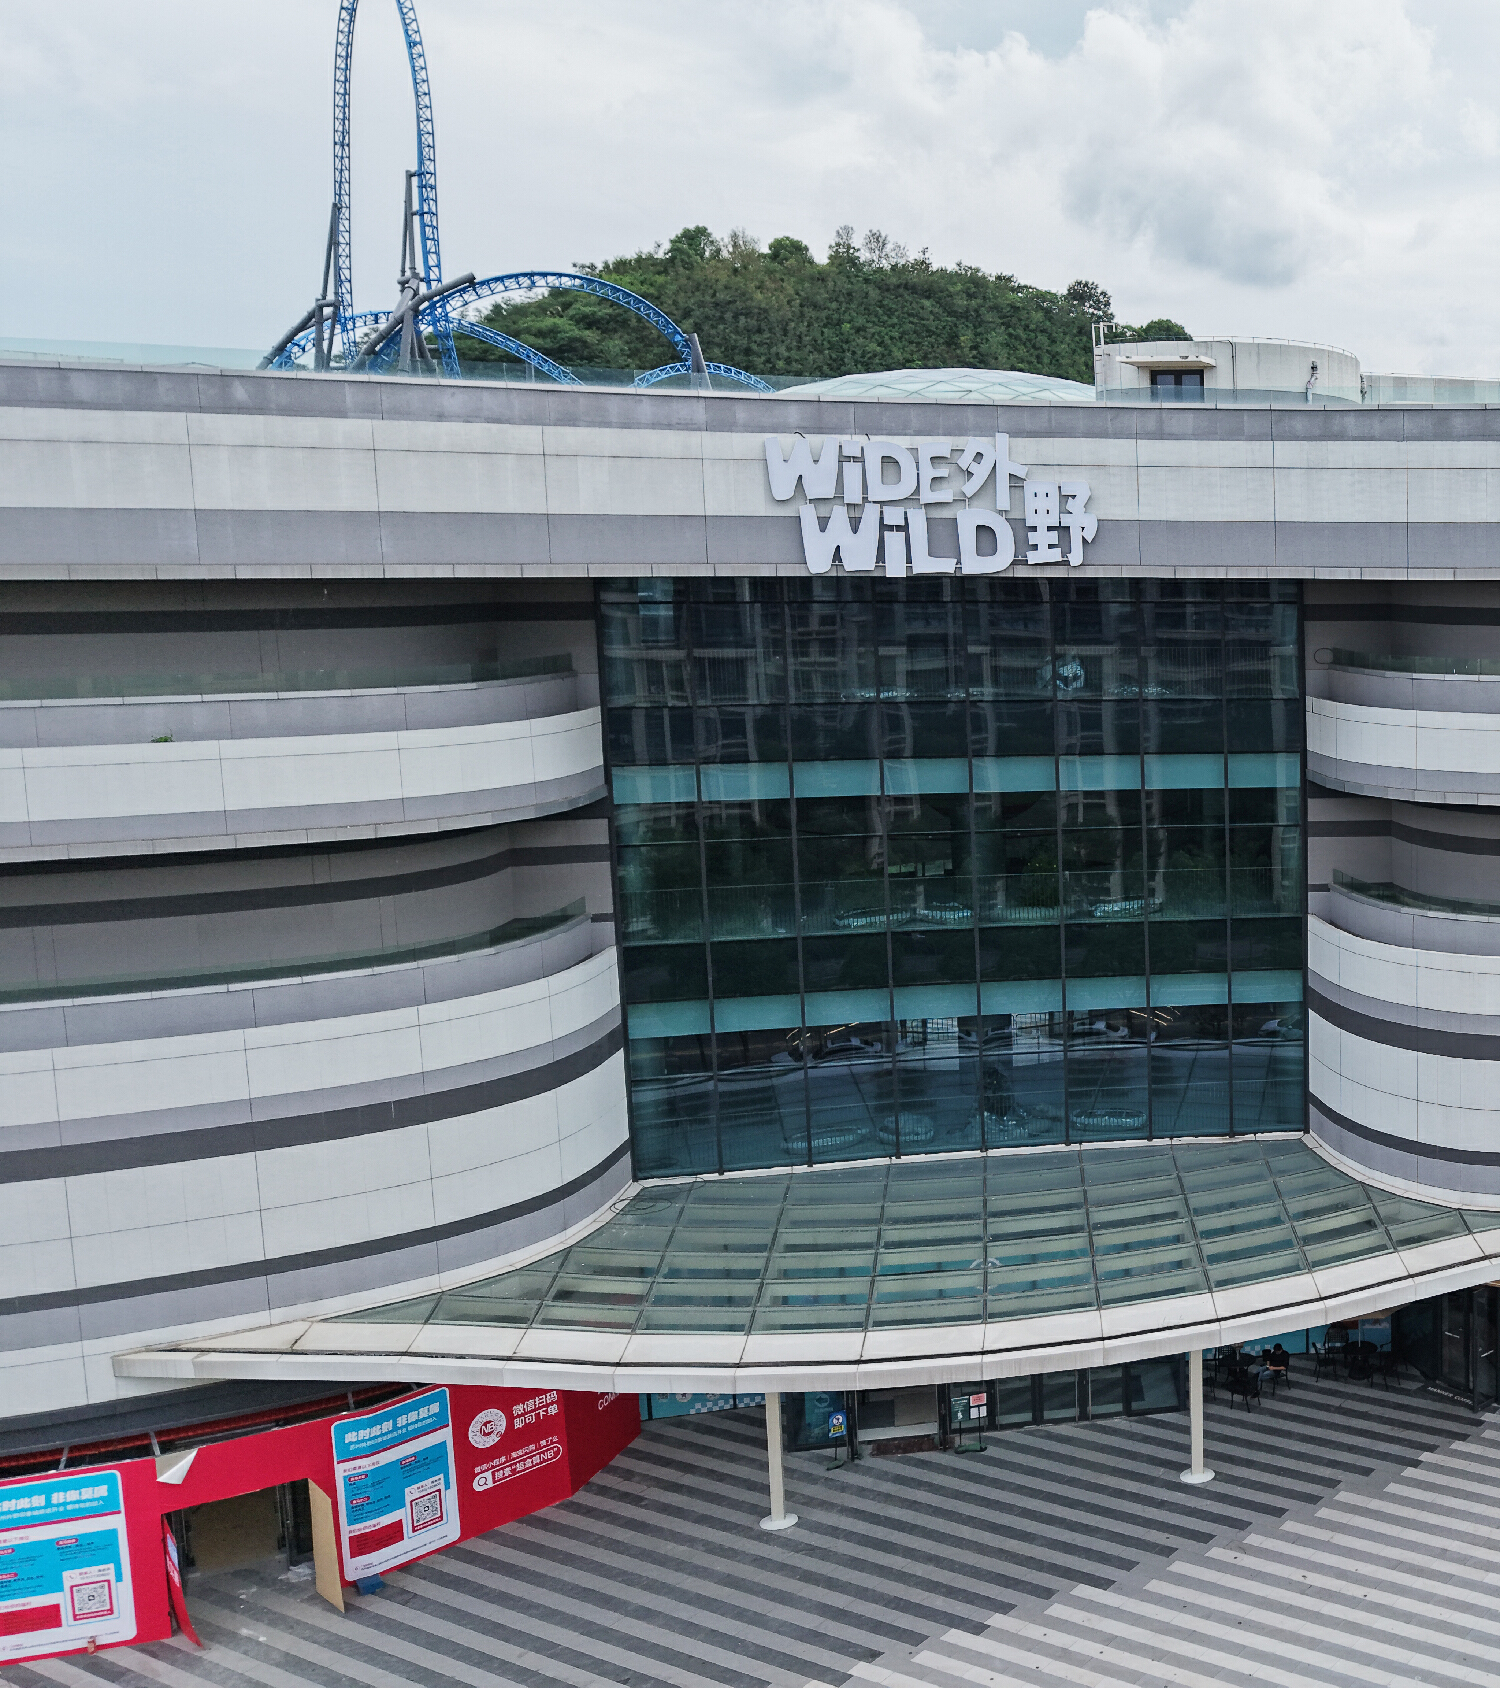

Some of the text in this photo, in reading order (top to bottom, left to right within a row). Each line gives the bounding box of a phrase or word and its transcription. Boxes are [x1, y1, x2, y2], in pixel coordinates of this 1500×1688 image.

[512, 1390, 558, 1416] 微信扫码
[513, 1403, 559, 1429] 即可下单
[481, 1421, 495, 1436] NB
